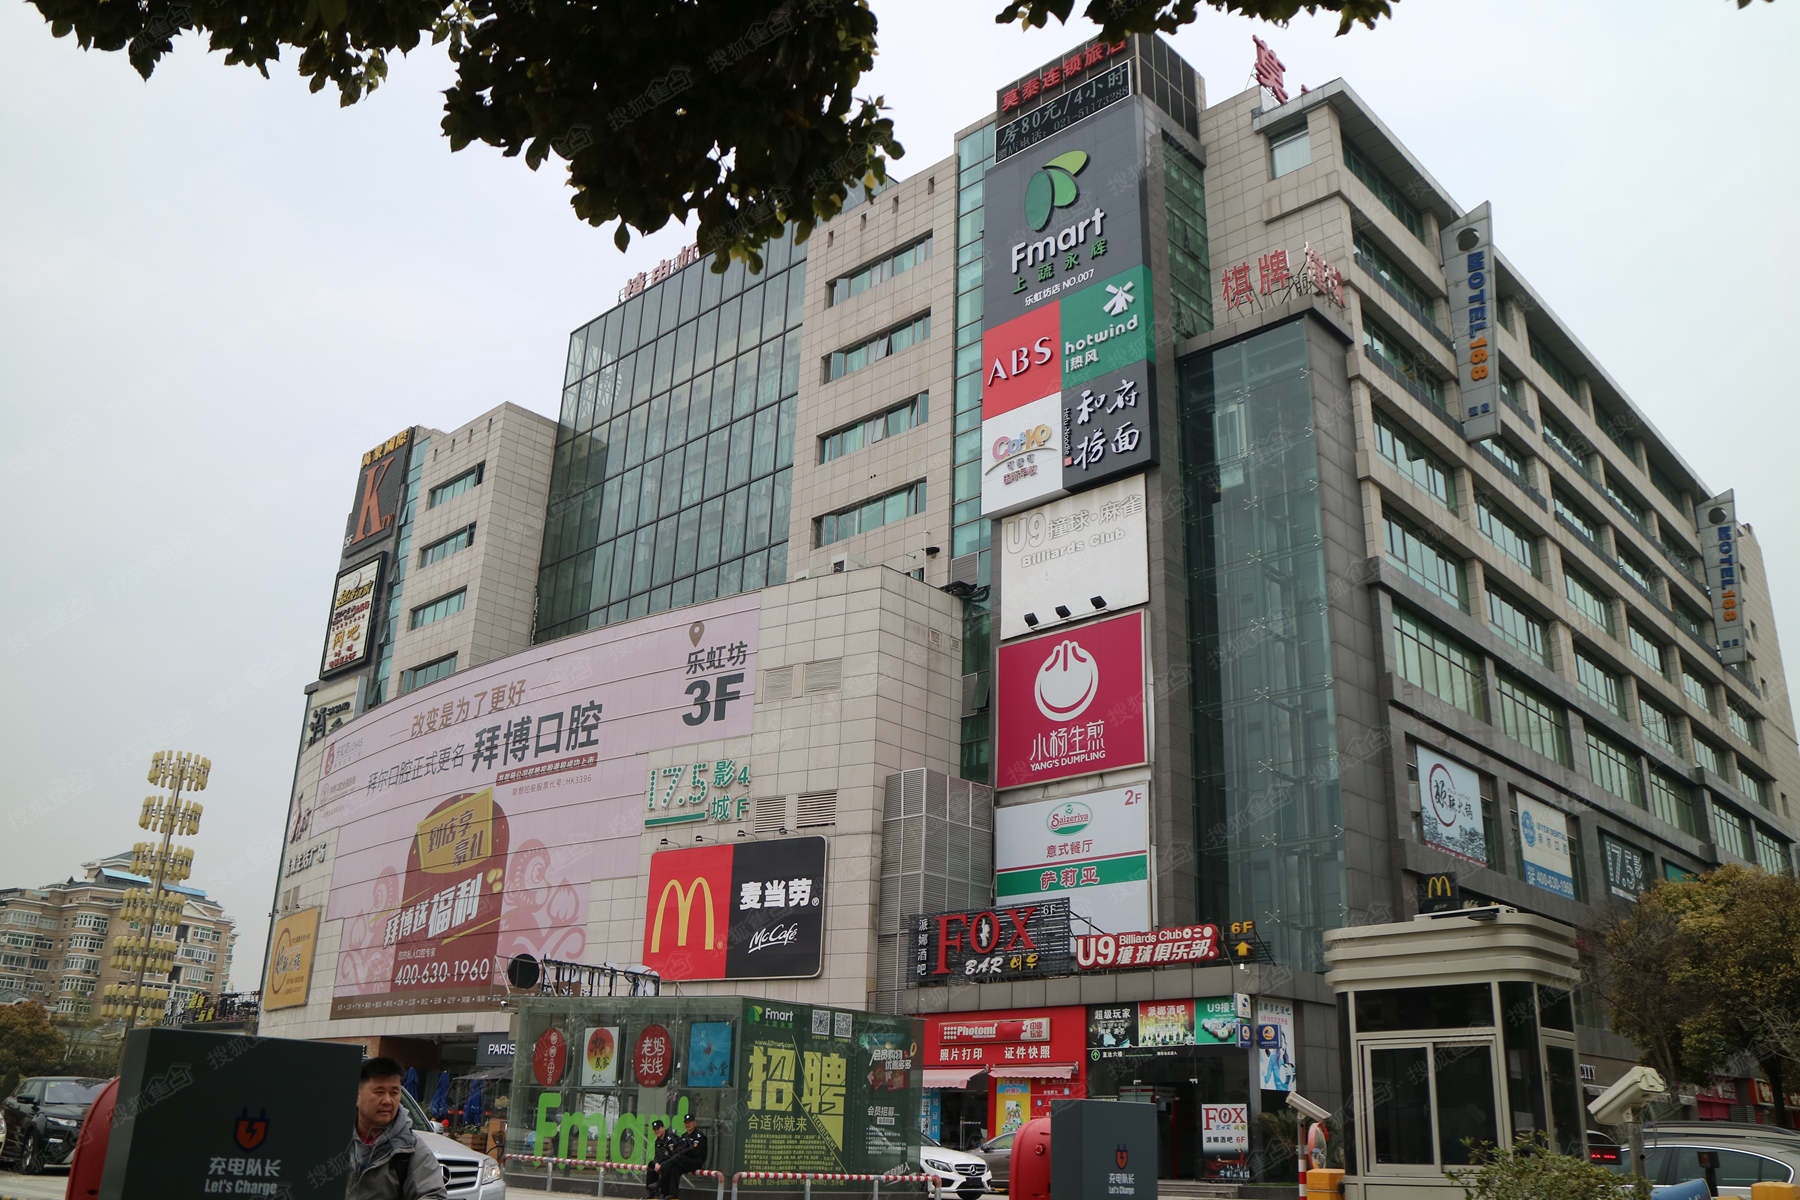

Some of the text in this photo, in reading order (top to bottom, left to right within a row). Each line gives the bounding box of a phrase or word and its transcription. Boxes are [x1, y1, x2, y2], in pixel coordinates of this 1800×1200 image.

[1011, 207, 1106, 274] Fmart
[1011, 239, 1108, 294] 上蔬永辉
[1221, 249, 1291, 312] 棋牌
[1025, 282, 1061, 307] 乐虹坊店
[1466, 250, 1488, 339] MOTEL
[1064, 314, 1139, 355] hotwind
[986, 335, 1053, 387] ABS
[1069, 348, 1099, 371] 热风
[1075, 378, 1140, 426] 和府
[1073, 420, 1140, 470] 捞面
[1006, 512, 1047, 555] U9
[1020, 528, 1126, 569] Billiards Club
[1716, 525, 1736, 590] MOTEL
[686, 640, 749, 675] 乐虹坊
[410, 678, 527, 739] 改变是为了更好
[681, 672, 746, 728] 3F
[366, 742, 466, 798] 拜尔口腔正式更名
[470, 699, 604, 774] 拜博口腔
[1029, 718, 1106, 762] 小杨生煎
[1029, 749, 1107, 773] YANG'S DUMPLING
[648, 763, 710, 812] 17.5
[1124, 788, 1143, 807] 2F
[1050, 812, 1090, 830] Saizeriya
[1045, 838, 1094, 859] 意式餐厅
[739, 877, 813, 911] 麦当劳
[1040, 866, 1100, 890] 萨莉亚
[382, 872, 483, 949] 拜博送福利
[1230, 920, 1254, 935] 6F
[930, 903, 1057, 975] FOX 6F
[1076, 927, 1183, 968] U9 Billiards Club
[393, 957, 491, 986] 400-630-1960
[964, 956, 1004, 976] BAR
[765, 1007, 793, 1022] Fmart
[1094, 1008, 1131, 1020] 超级玩家
[487, 1043, 517, 1056] PARIS
[939, 1045, 1051, 1061] 照片打印 证件快照
[747, 1045, 847, 1115] 招聘
[747, 1113, 808, 1133] 合适你就来
[1203, 1107, 1247, 1131] FOX
[207, 1156, 282, 1177] 充电队长
[204, 1178, 279, 1196] Let's Charge
